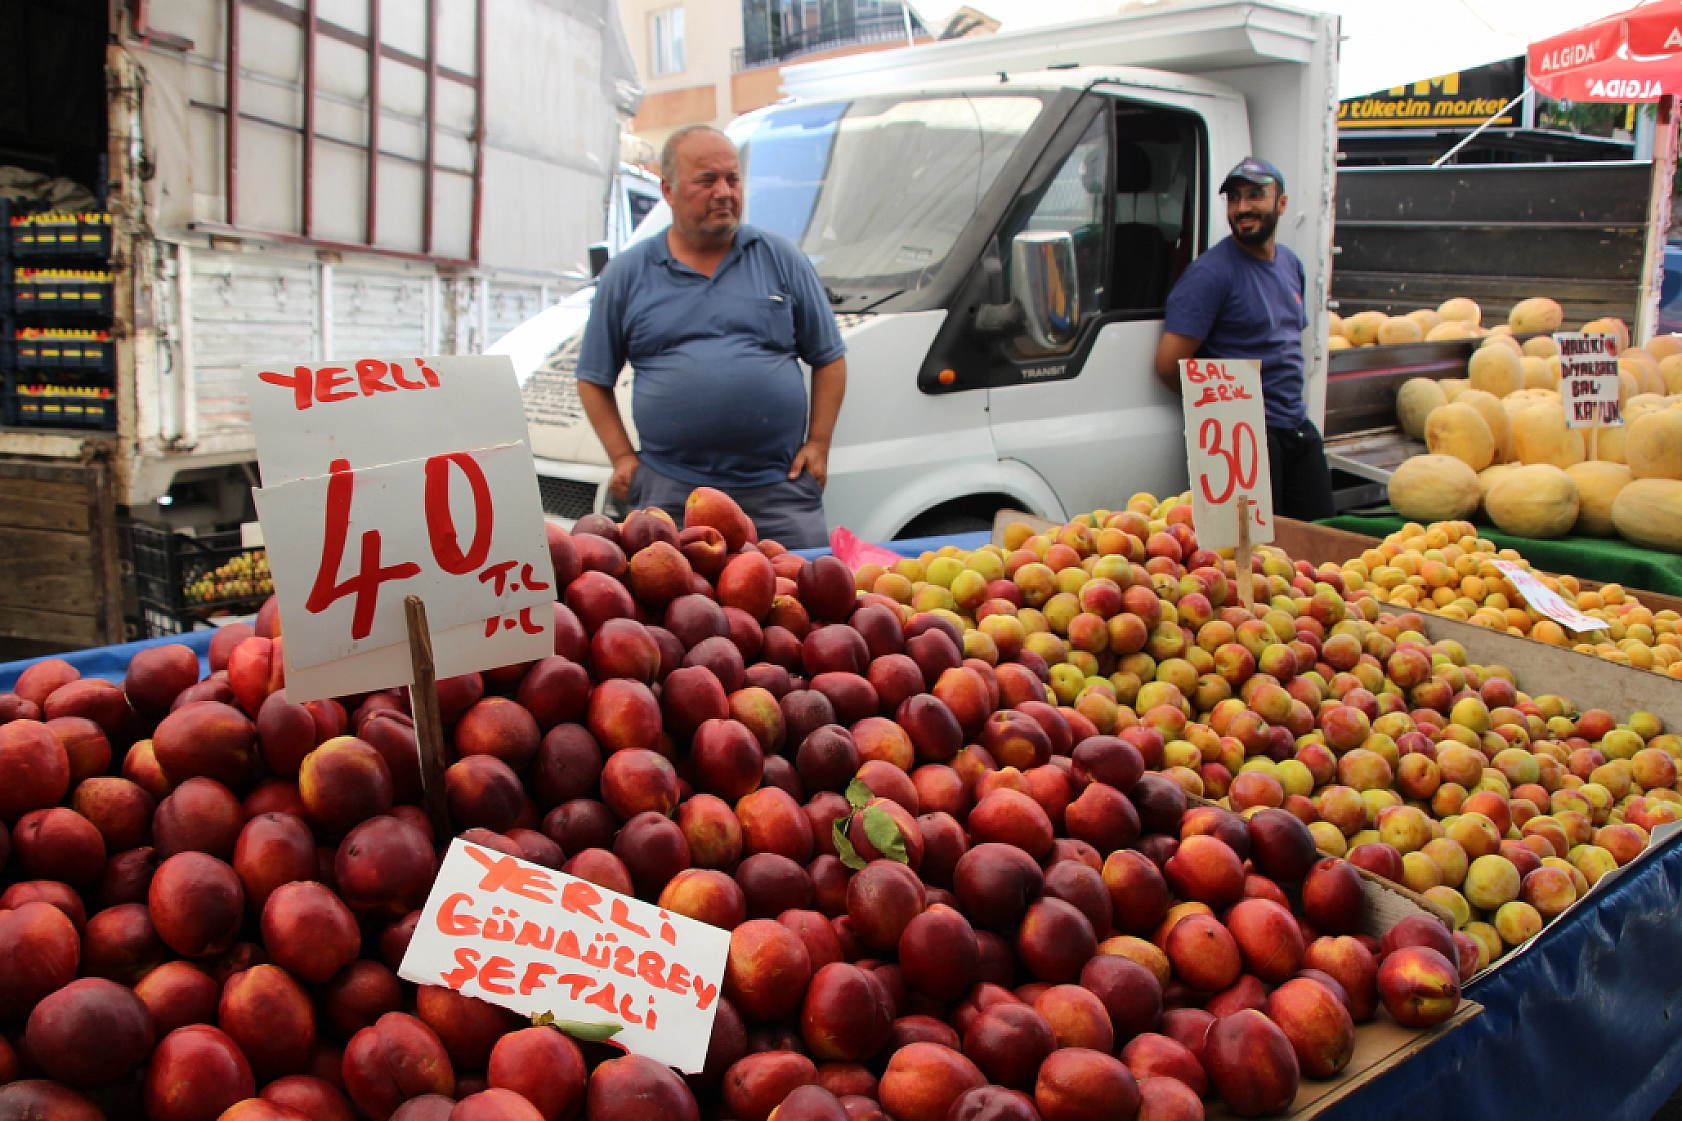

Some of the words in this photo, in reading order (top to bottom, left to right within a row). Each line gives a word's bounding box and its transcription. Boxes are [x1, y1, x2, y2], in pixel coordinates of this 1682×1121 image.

[1351, 98, 1430, 117] tüketim
[1433, 98, 1508, 116] market
[1022, 366, 1067, 379] TRANSIT
[1186, 358, 1236, 383] BAL
[1571, 381, 1599, 397] BAL
[1200, 418, 1258, 505] 30
[305, 452, 494, 640] 40
